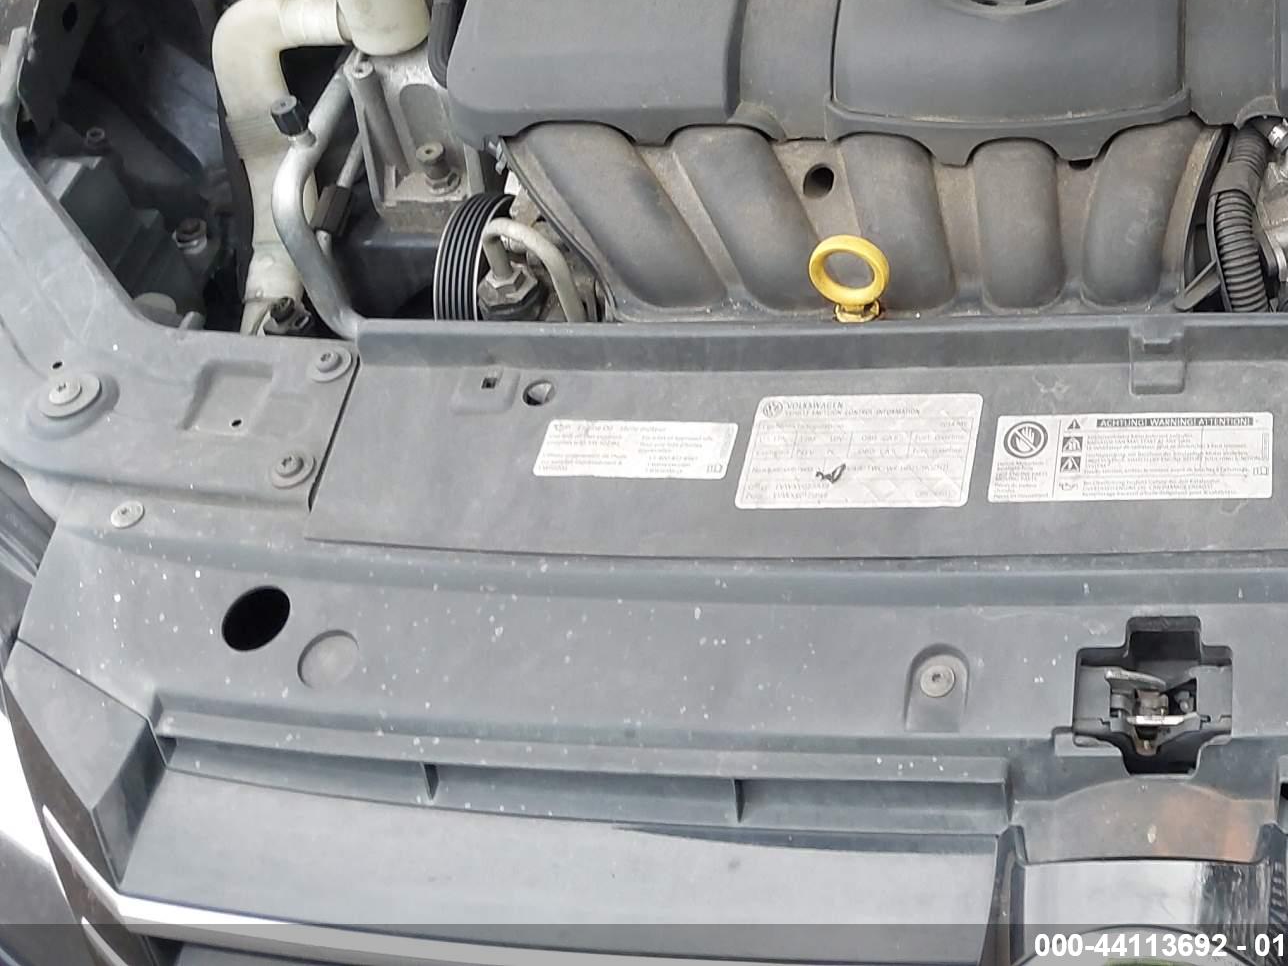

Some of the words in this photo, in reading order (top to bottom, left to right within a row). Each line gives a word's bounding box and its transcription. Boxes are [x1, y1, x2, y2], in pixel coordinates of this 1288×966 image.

[785, 401, 844, 410] VOLKSWAGEN
[1100, 418, 1147, 427] ACHTUNG!
[1149, 418, 1197, 427] WARNING!
[1198, 417, 1251, 426] ATTENTION!
